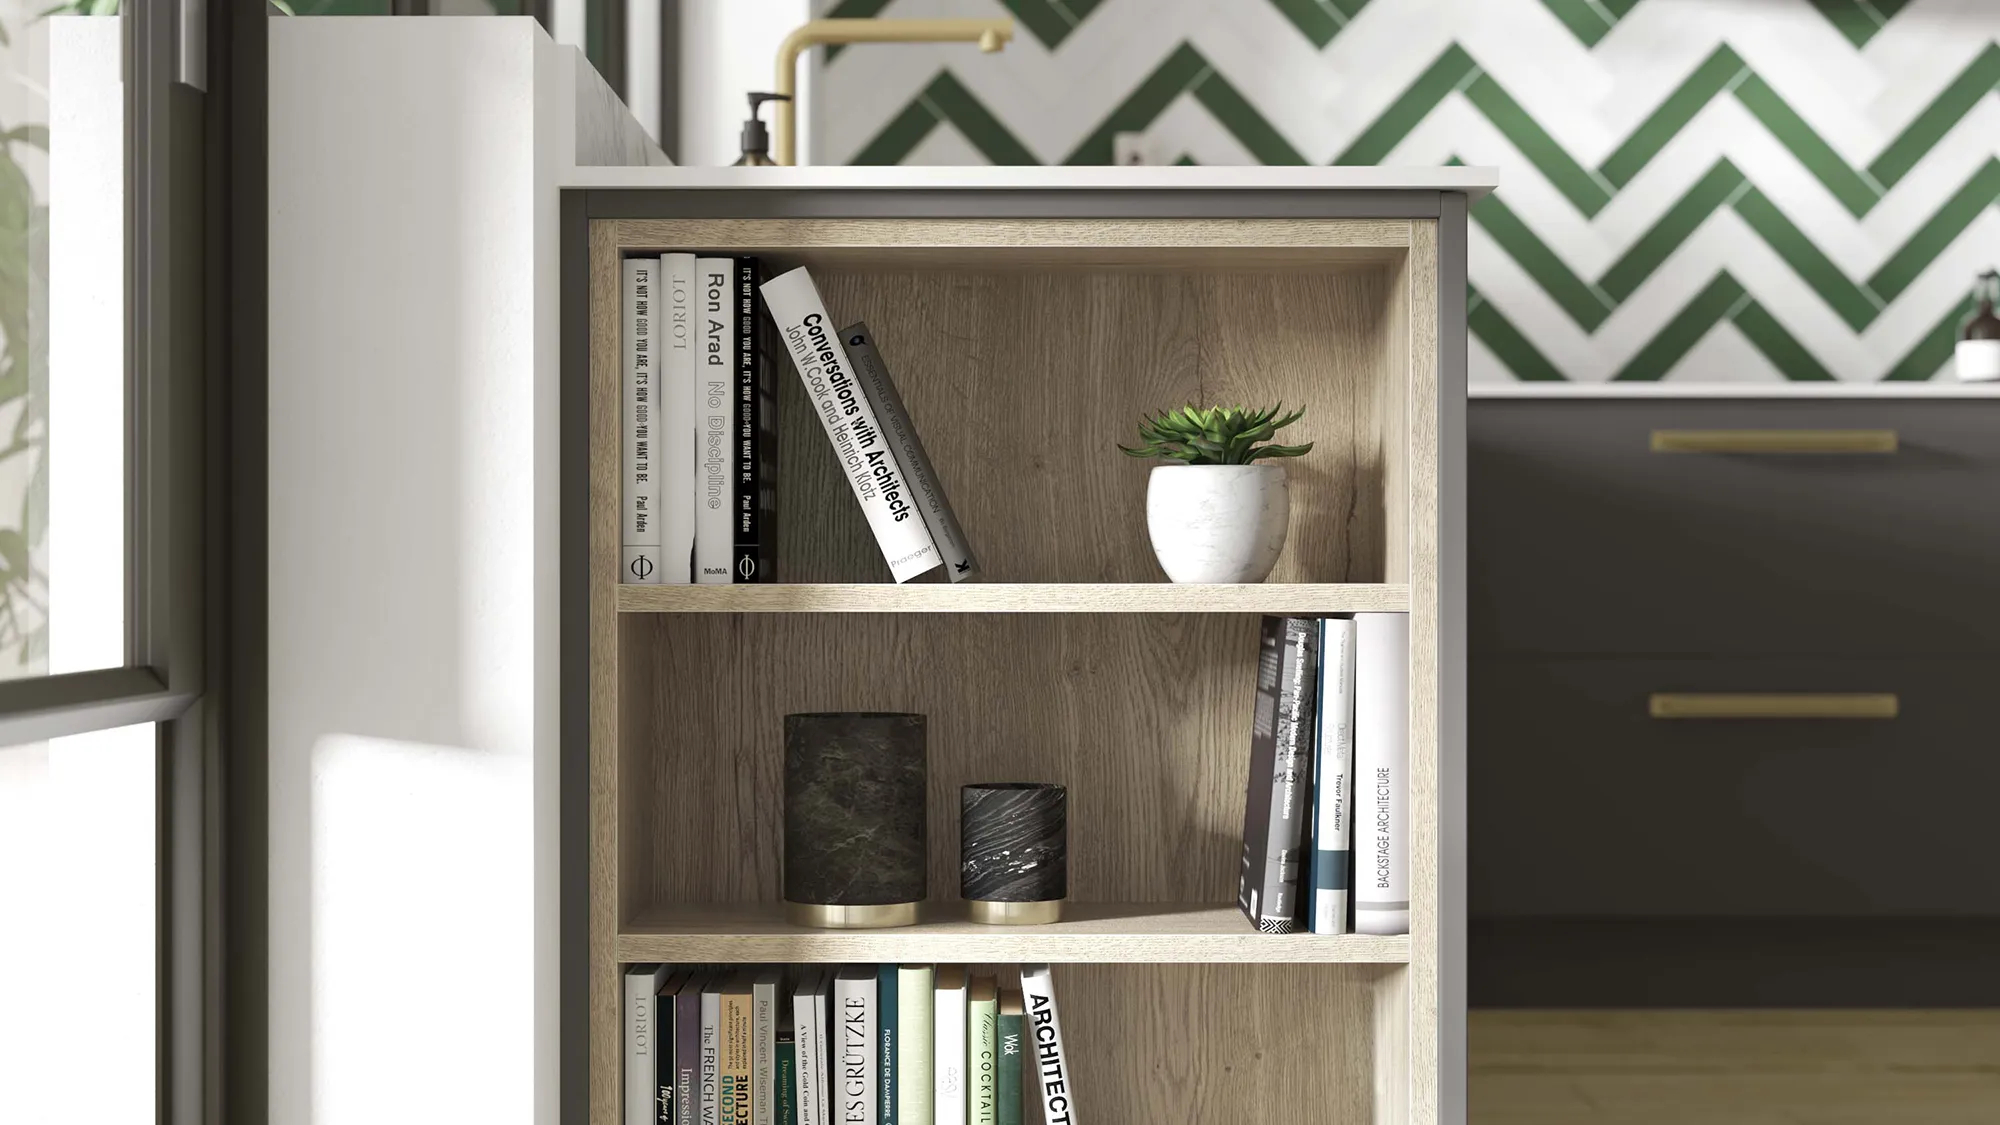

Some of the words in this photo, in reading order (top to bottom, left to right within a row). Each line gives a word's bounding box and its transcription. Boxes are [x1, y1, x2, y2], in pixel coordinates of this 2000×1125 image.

[636, 270, 648, 282] IT'S
[743, 268, 751, 281] IT'S
[636, 285, 648, 298] NOT
[708, 274, 724, 312] Ron
[743, 283, 751, 296] NOT
[636, 301, 648, 316] HOW
[673, 274, 686, 350] LORIOT
[743, 299, 751, 314] HOW
[636, 319, 648, 336] GOOD
[743, 317, 751, 334] GOOD
[636, 338, 648, 352] YOU
[708, 320, 724, 365] Arad
[743, 337, 751, 350] YOU
[635, 354, 648, 369] ARE,
[742, 353, 751, 368] ARE,
[636, 373, 648, 385] IT'S
[743, 371, 751, 383] IT'S
[636, 388, 648, 402] HOW
[708, 382, 725, 408] No
[743, 386, 751, 402] HOW
[636, 405, 648, 422] GOOD
[786, 325, 807, 354] John
[821, 400, 844, 425] and
[833, 423, 864, 473] Heinrich
[855, 470, 877, 502] Klotz
[803, 313, 859, 416] Conversations
[851, 416, 877, 449] with
[865, 450, 910, 522] Architects
[636, 425, 648, 438] YOU
[743, 424, 751, 437] YOU
[861, 355, 888, 403] ESSENTIALS
[884, 403, 896, 415] OF
[890, 416, 907, 445] VISUAL
[904, 444, 940, 514] COMMUNICATION
[636, 441, 648, 460] WANT
[743, 440, 751, 459] WANT
[704, 416, 725, 509] Discipline
[636, 474, 648, 484] BE.
[743, 473, 751, 483] BE.
[636, 496, 648, 510] Paul
[743, 496, 751, 510] Paul
[636, 513, 648, 532] Arden
[743, 513, 751, 532] Arden
[1296, 632, 1306, 657] Douglas
[1286, 747, 1296, 768] Design
[1283, 781, 1294, 819] Architecture
[1377, 768, 1390, 834] ARCHITECTURE
[1335, 799, 1343, 831] Faulkner
[1377, 836, 1390, 888] BACKSTAGE
[760, 1000, 768, 1022] Paul
[635, 994, 647, 1056] LORIOT
[704, 1025, 713, 1044] The
[980, 1013, 993, 1046] Classic
[760, 1024, 768, 1063] Vincent
[842, 997, 864, 1097] GRÜTZKE
[1004, 1034, 1019, 1056] Wok
[1030, 994, 1072, 1125] ARCHITECT
[703, 1048, 715, 1102] FRENCH
[884, 1069, 891, 1078] DE
[760, 1067, 768, 1113] Wiseman
[981, 1051, 992, 1123] COCKTAIL
[722, 1075, 734, 1125] ECOND
[782, 1100, 790, 1109] of
[845, 1100, 864, 1125] ES
